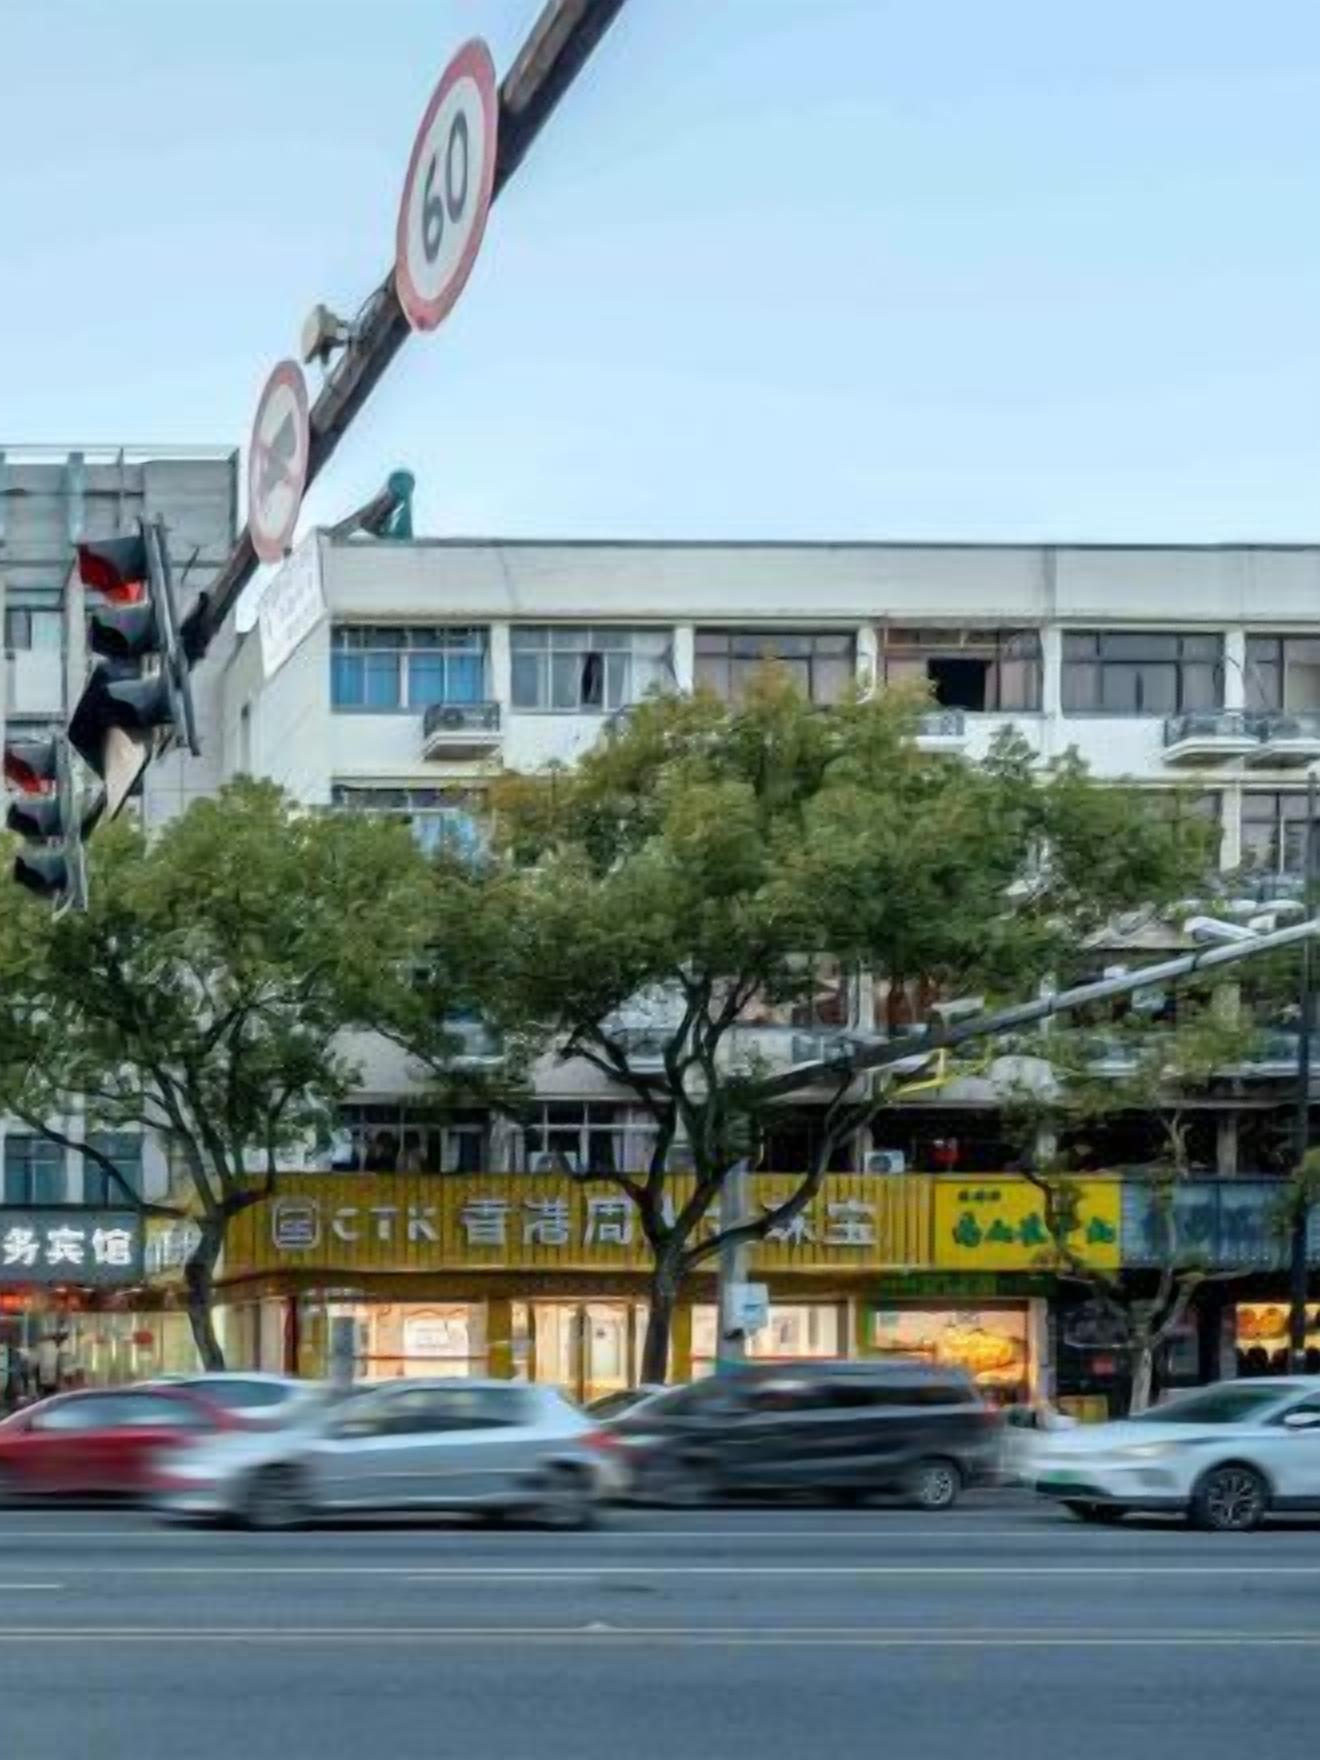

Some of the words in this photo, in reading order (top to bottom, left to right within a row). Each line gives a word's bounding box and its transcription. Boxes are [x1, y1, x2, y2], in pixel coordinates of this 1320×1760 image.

[422, 109, 468, 265] 60
[332, 1206, 440, 1242] CTK
[462, 1196, 877, 1246] 香港周珠宝
